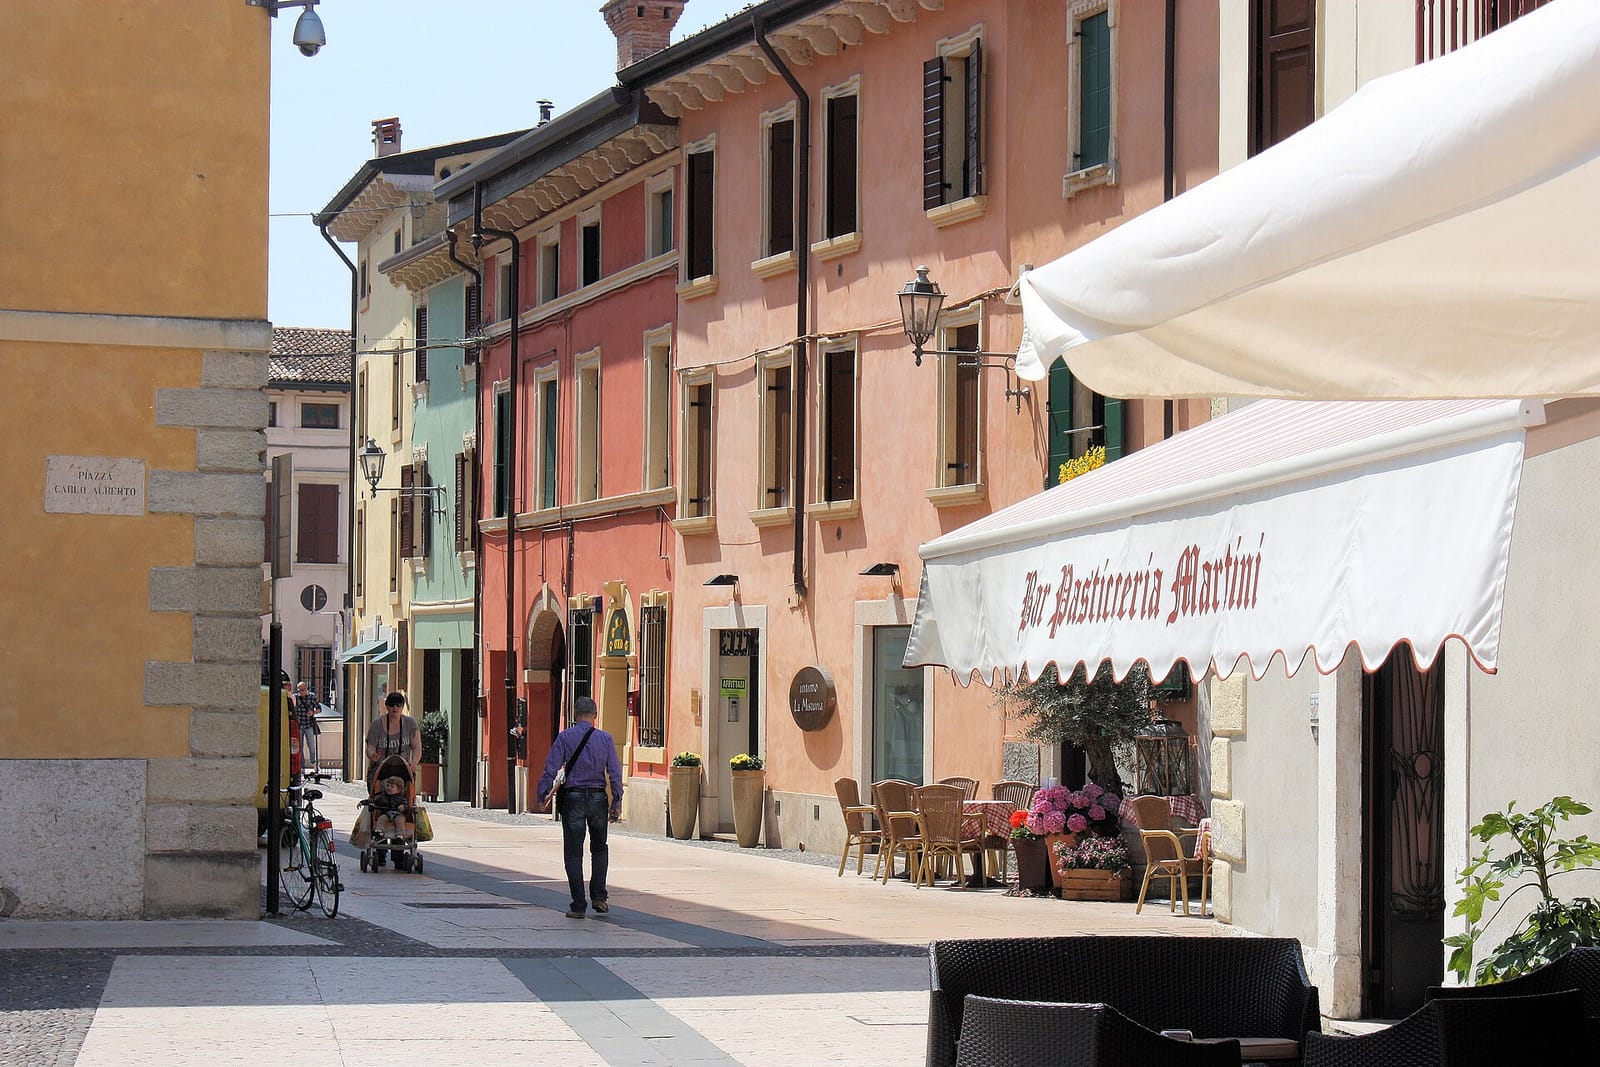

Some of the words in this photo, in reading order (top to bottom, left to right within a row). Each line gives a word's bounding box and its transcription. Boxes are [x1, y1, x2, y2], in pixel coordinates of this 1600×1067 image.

[78, 471, 113, 481] PIAZZA
[54, 485, 87, 495] CARLO
[93, 487, 137, 496] ALBERTO
[1017, 569, 1051, 642] Bar
[1047, 552, 1164, 640] Pasticceria
[1166, 532, 1265, 628] Martini
[793, 698, 801, 712] La
